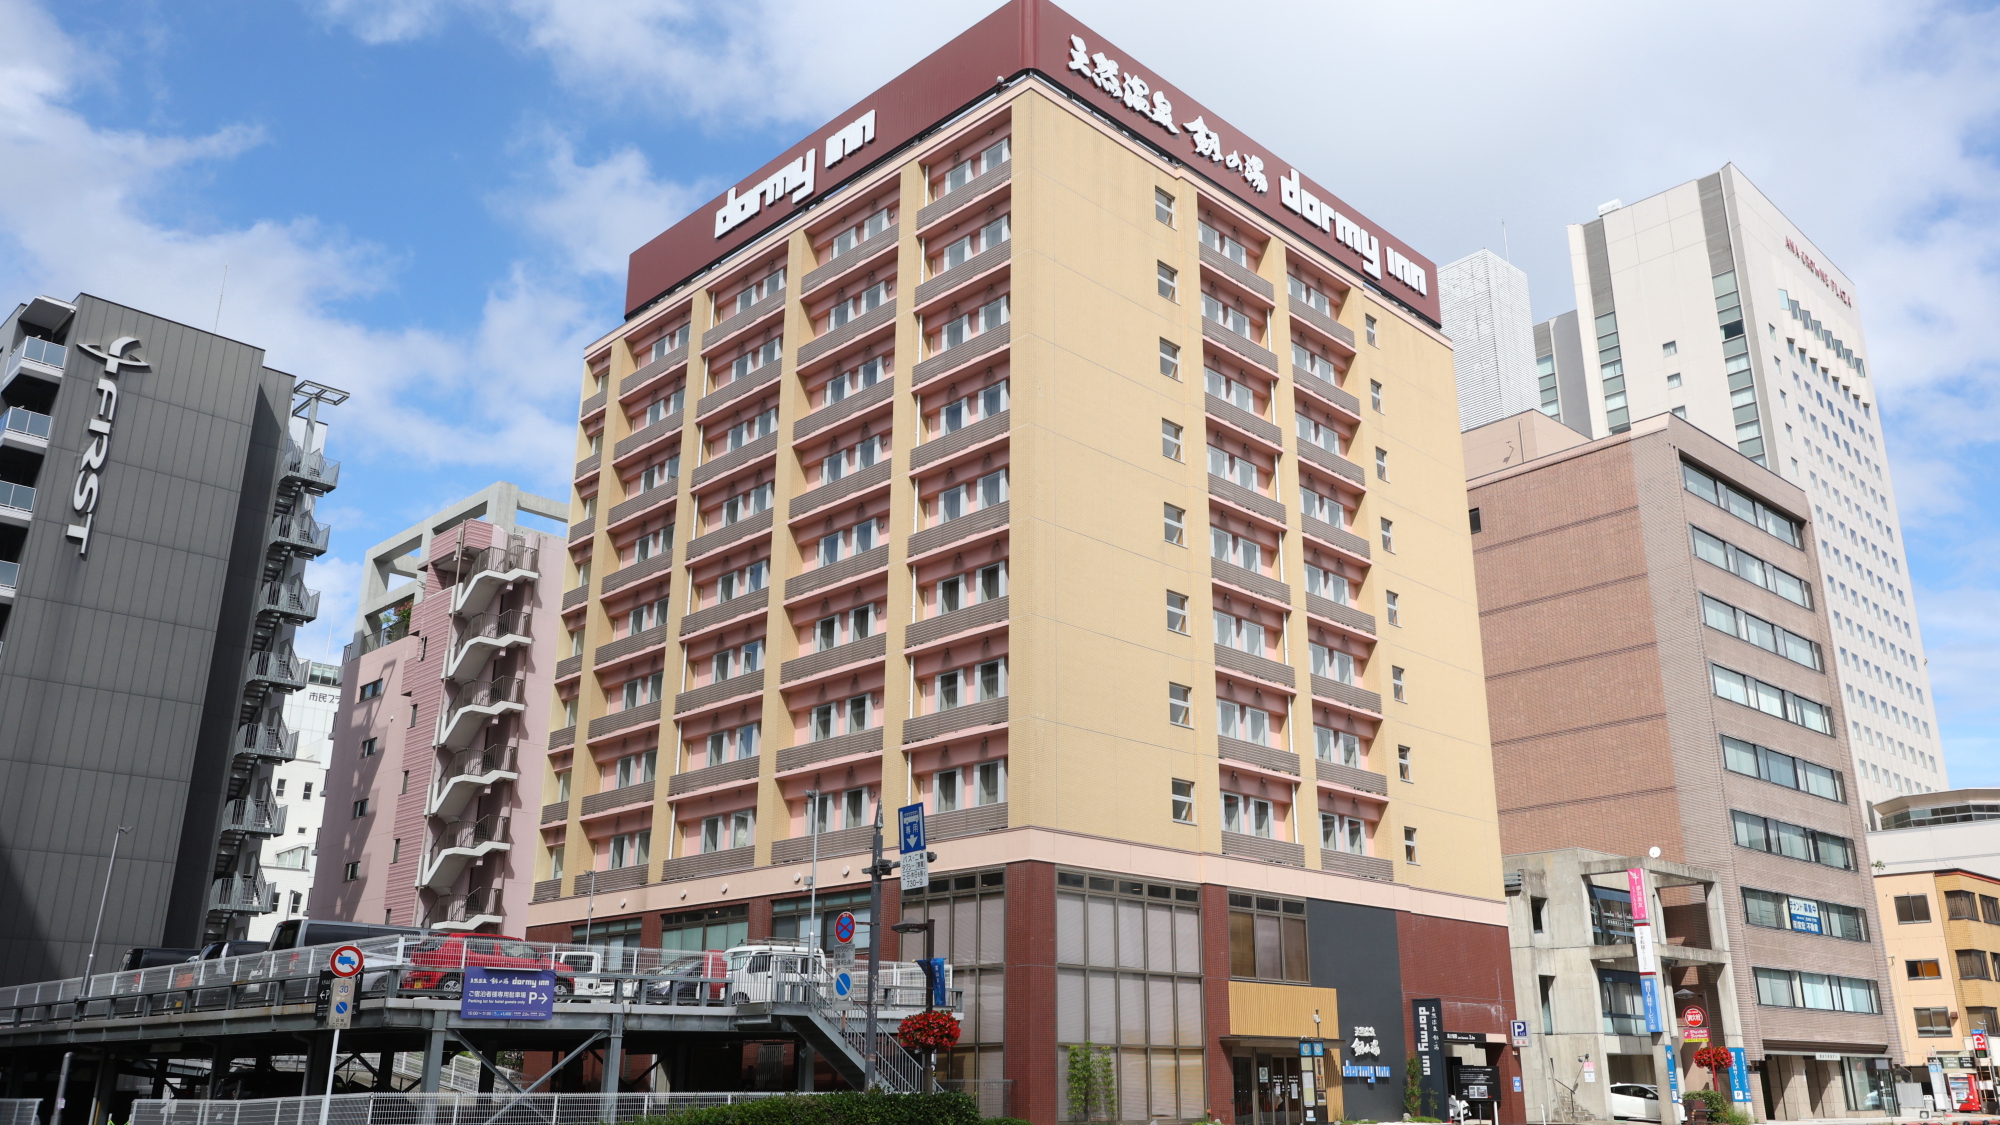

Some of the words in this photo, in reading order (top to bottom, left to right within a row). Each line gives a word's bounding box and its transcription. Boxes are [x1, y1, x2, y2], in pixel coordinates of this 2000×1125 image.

[714, 147, 817, 239] dormy
[824, 108, 876, 169] inn
[1067, 33, 1181, 135] 天然温泉
[1279, 167, 1382, 280] dormy
[1386, 245, 1428, 296] inn
[1785, 235, 1800, 259] ANA
[1830, 278, 1852, 309] PLAZA
[66, 378, 118, 554] FIRST
[905, 823, 919, 835] 専用
[338, 985, 349, 994] 30
[512, 977, 537, 988] dormy
[528, 991, 538, 1005] P
[1417, 1006, 1430, 1052] dormy
[1514, 1022, 1524, 1037] P
[1972, 1035, 1984, 1049] P
[1342, 1059, 1376, 1084] dormy
[1376, 1066, 1391, 1078] inn
[1422, 1055, 1431, 1076] inn
